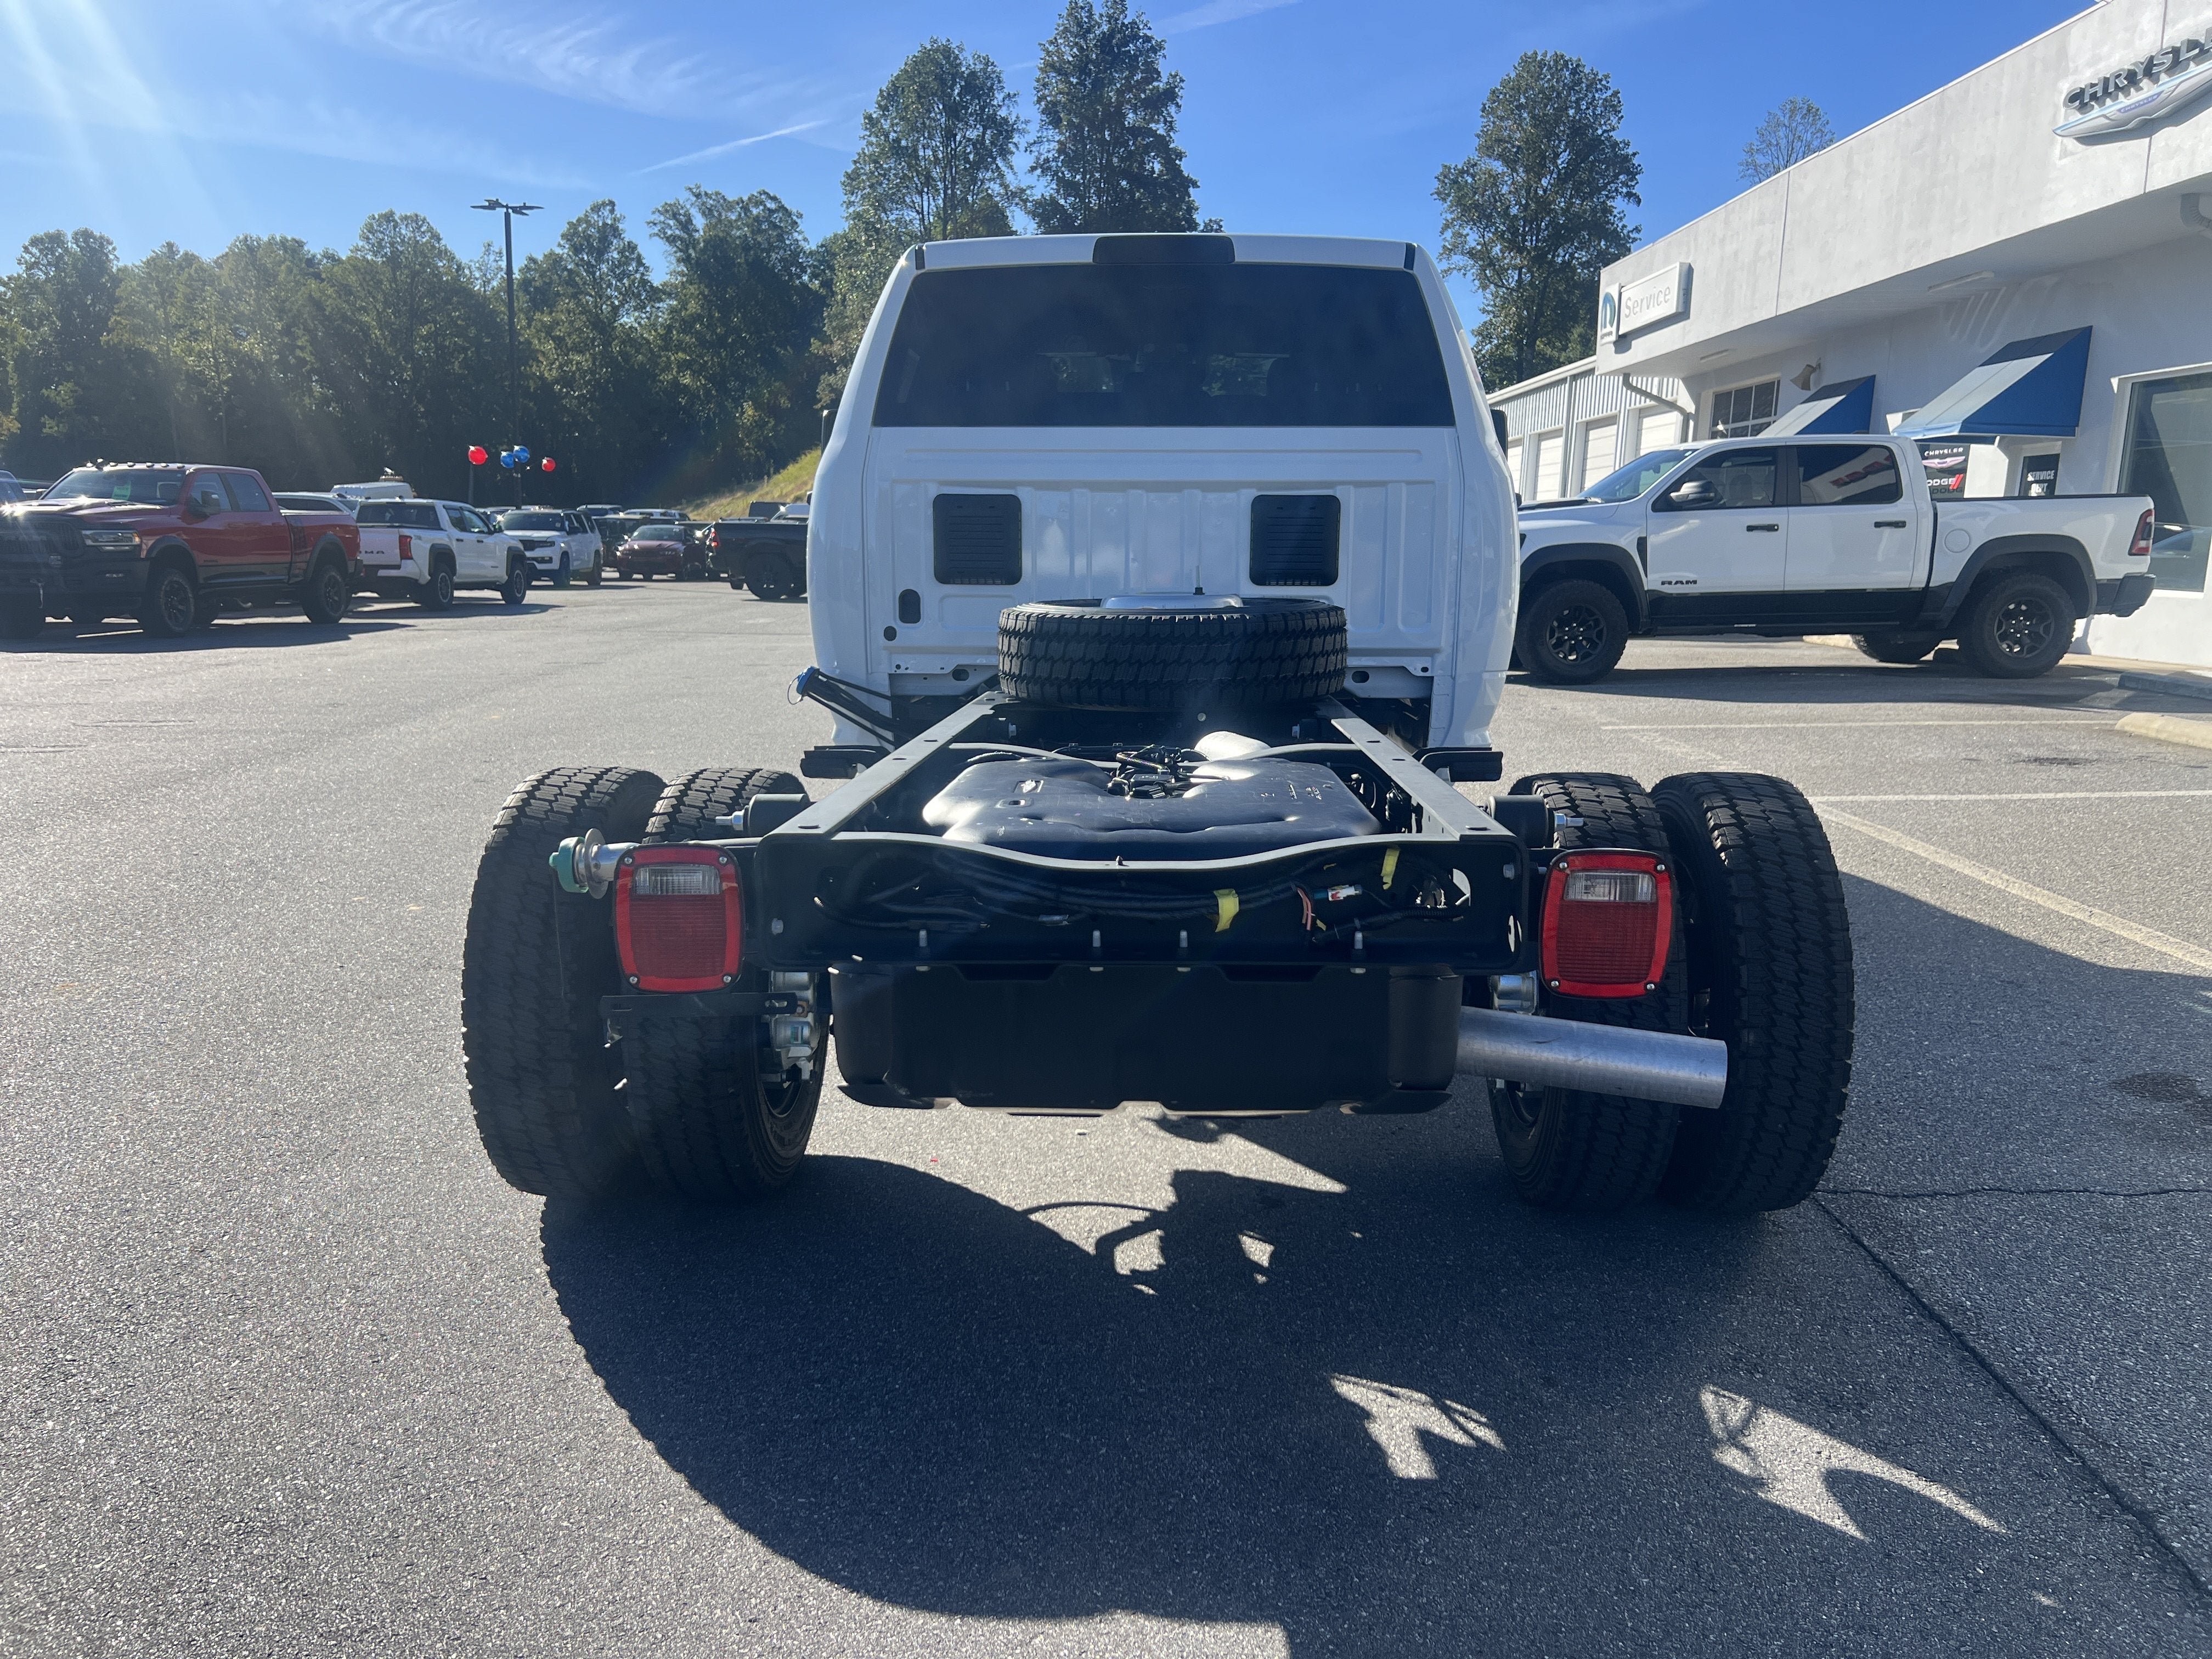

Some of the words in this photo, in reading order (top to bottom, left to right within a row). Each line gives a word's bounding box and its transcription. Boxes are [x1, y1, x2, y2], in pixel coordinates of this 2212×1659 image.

[1624, 286, 1671, 318] Service
[1924, 447, 1963, 456] CHRYSLER
[2027, 470, 2055, 482] SERVICE
[1926, 478, 1956, 487] ODGE
